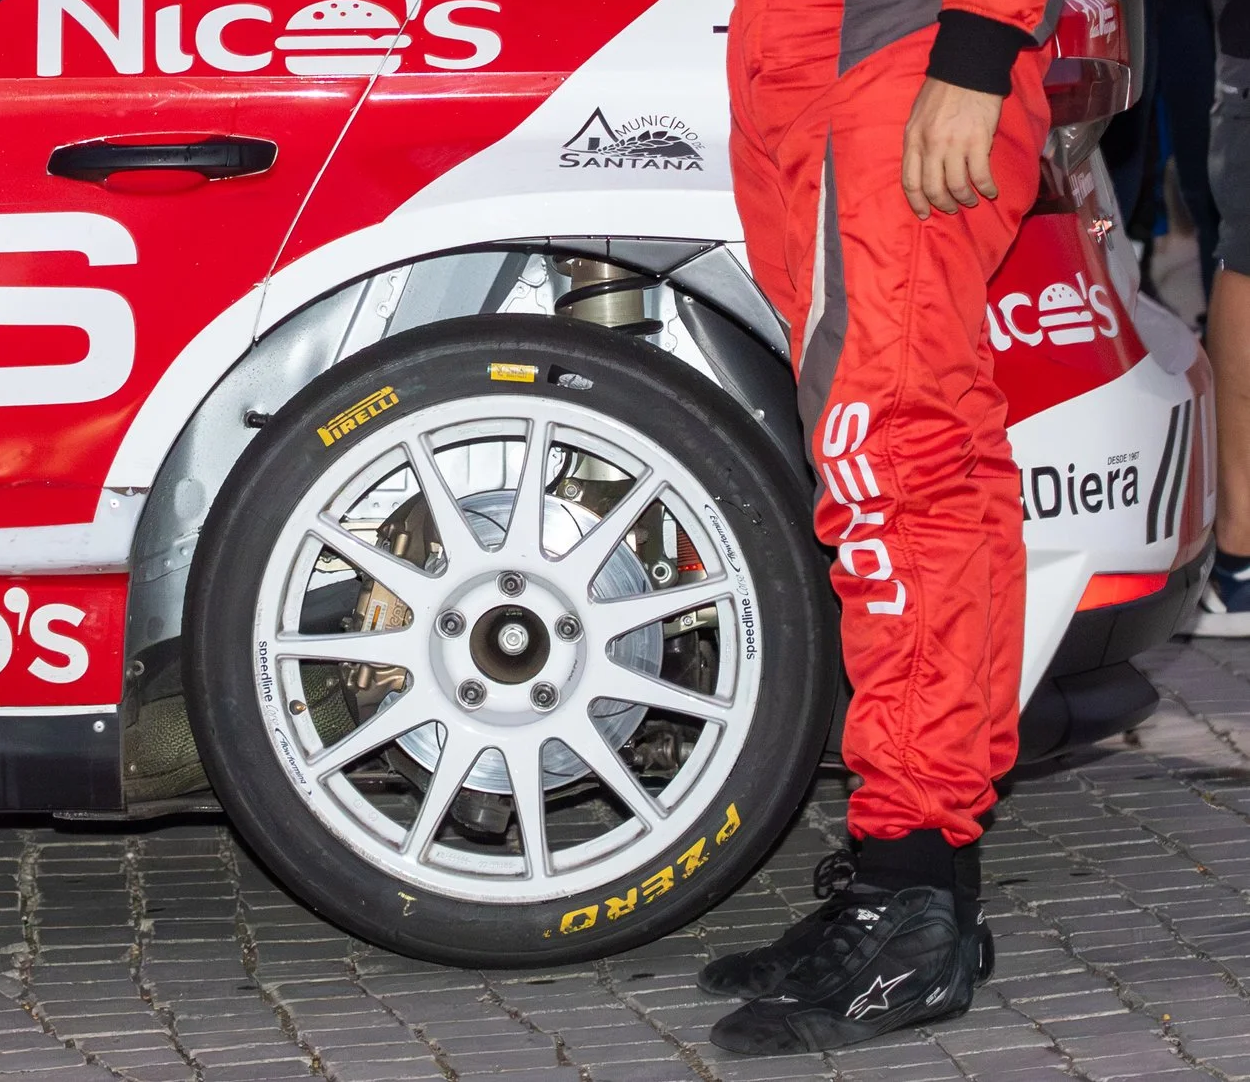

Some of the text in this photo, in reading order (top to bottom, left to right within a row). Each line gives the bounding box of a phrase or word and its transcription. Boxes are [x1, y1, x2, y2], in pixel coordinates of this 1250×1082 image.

[614, 114, 699, 142] MUNICÍPIO
[558, 152, 705, 172] SANTANA
[316, 385, 401, 448] PIRELLI
[1031, 463, 1140, 520] Diera
[1107, 454, 1129, 466] DESDE
[821, 401, 907, 616] LOTES
[741, 597, 756, 660] speedline
[258, 640, 273, 704] speedline
[559, 836, 711, 935] ZERO
